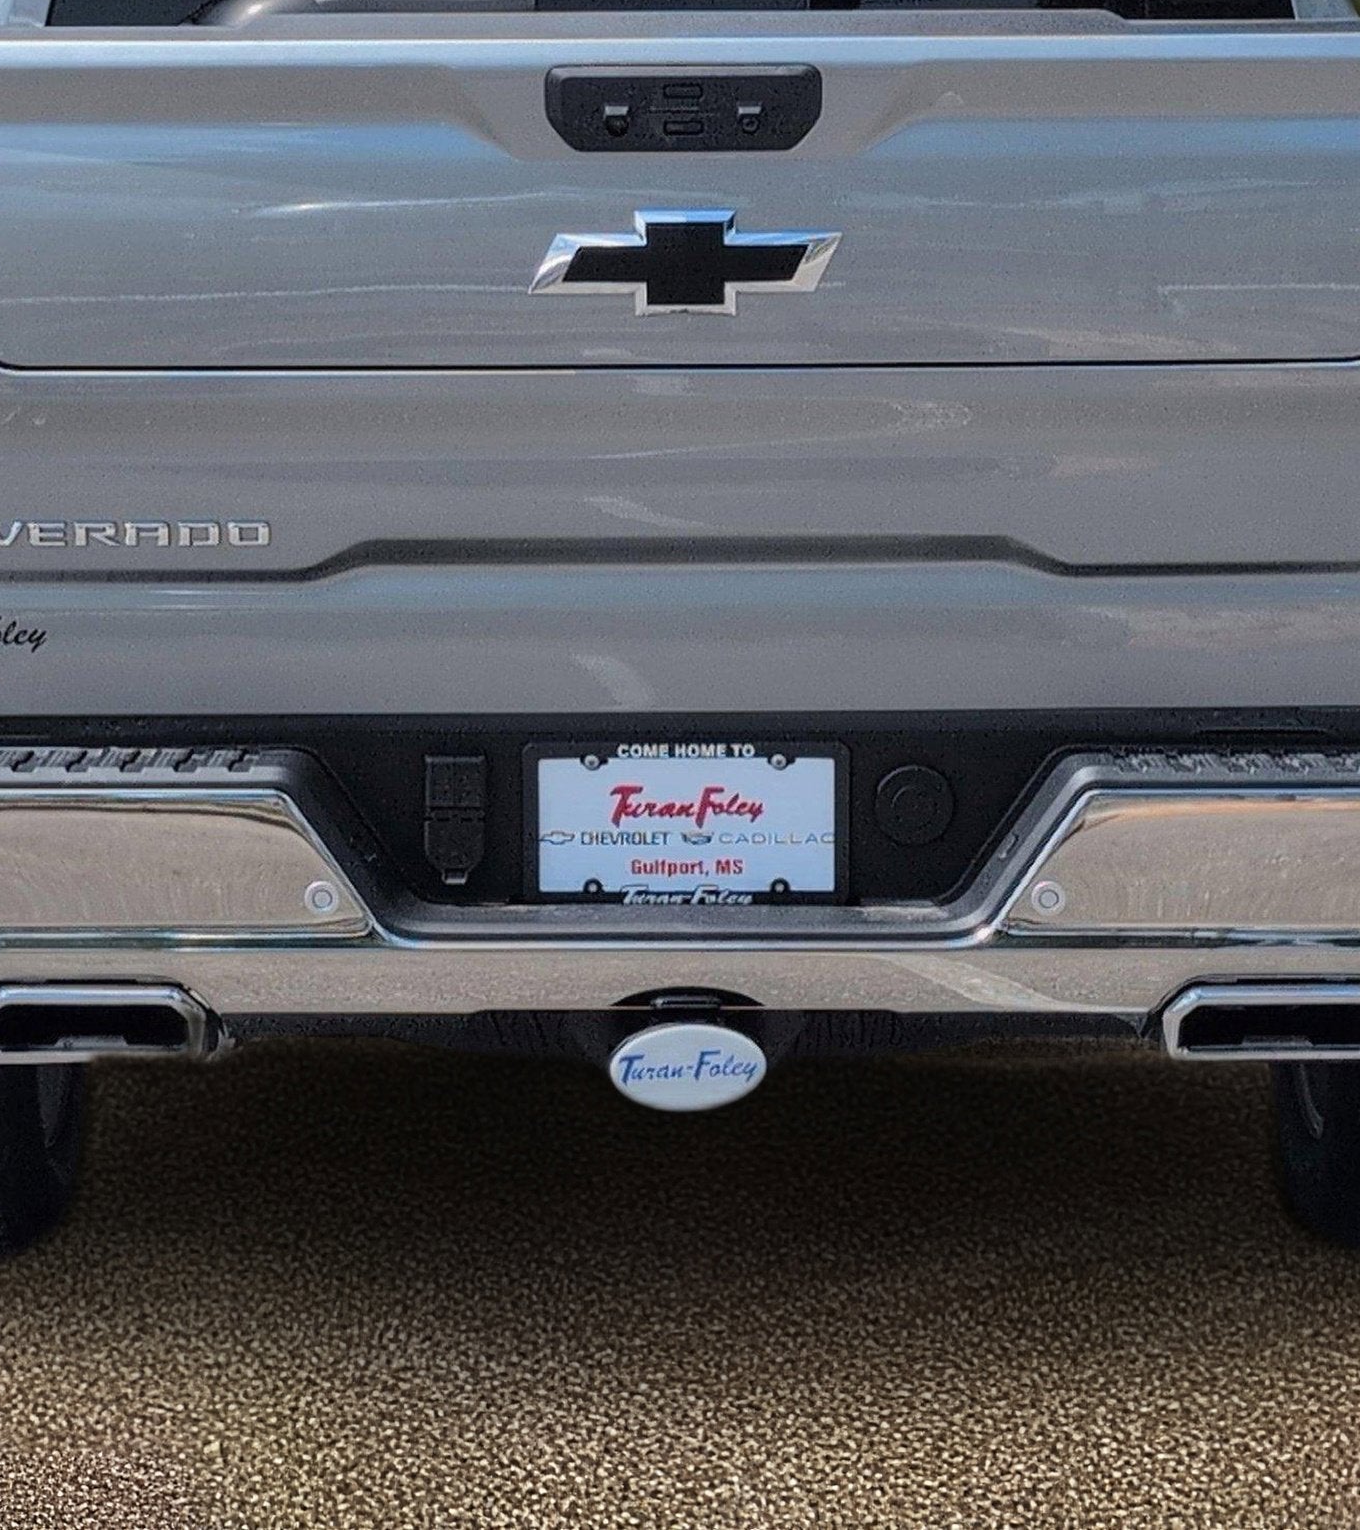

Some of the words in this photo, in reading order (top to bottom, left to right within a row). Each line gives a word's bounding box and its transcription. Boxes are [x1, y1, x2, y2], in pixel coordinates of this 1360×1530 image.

[617, 742, 669, 758] COME
[674, 742, 726, 758] HOME
[730, 742, 756, 758] TO
[580, 831, 670, 846] CHEVROLET
[718, 831, 835, 845] CADILLAC
[630, 859, 710, 877] Gulfport,
[715, 859, 744, 875] MS
